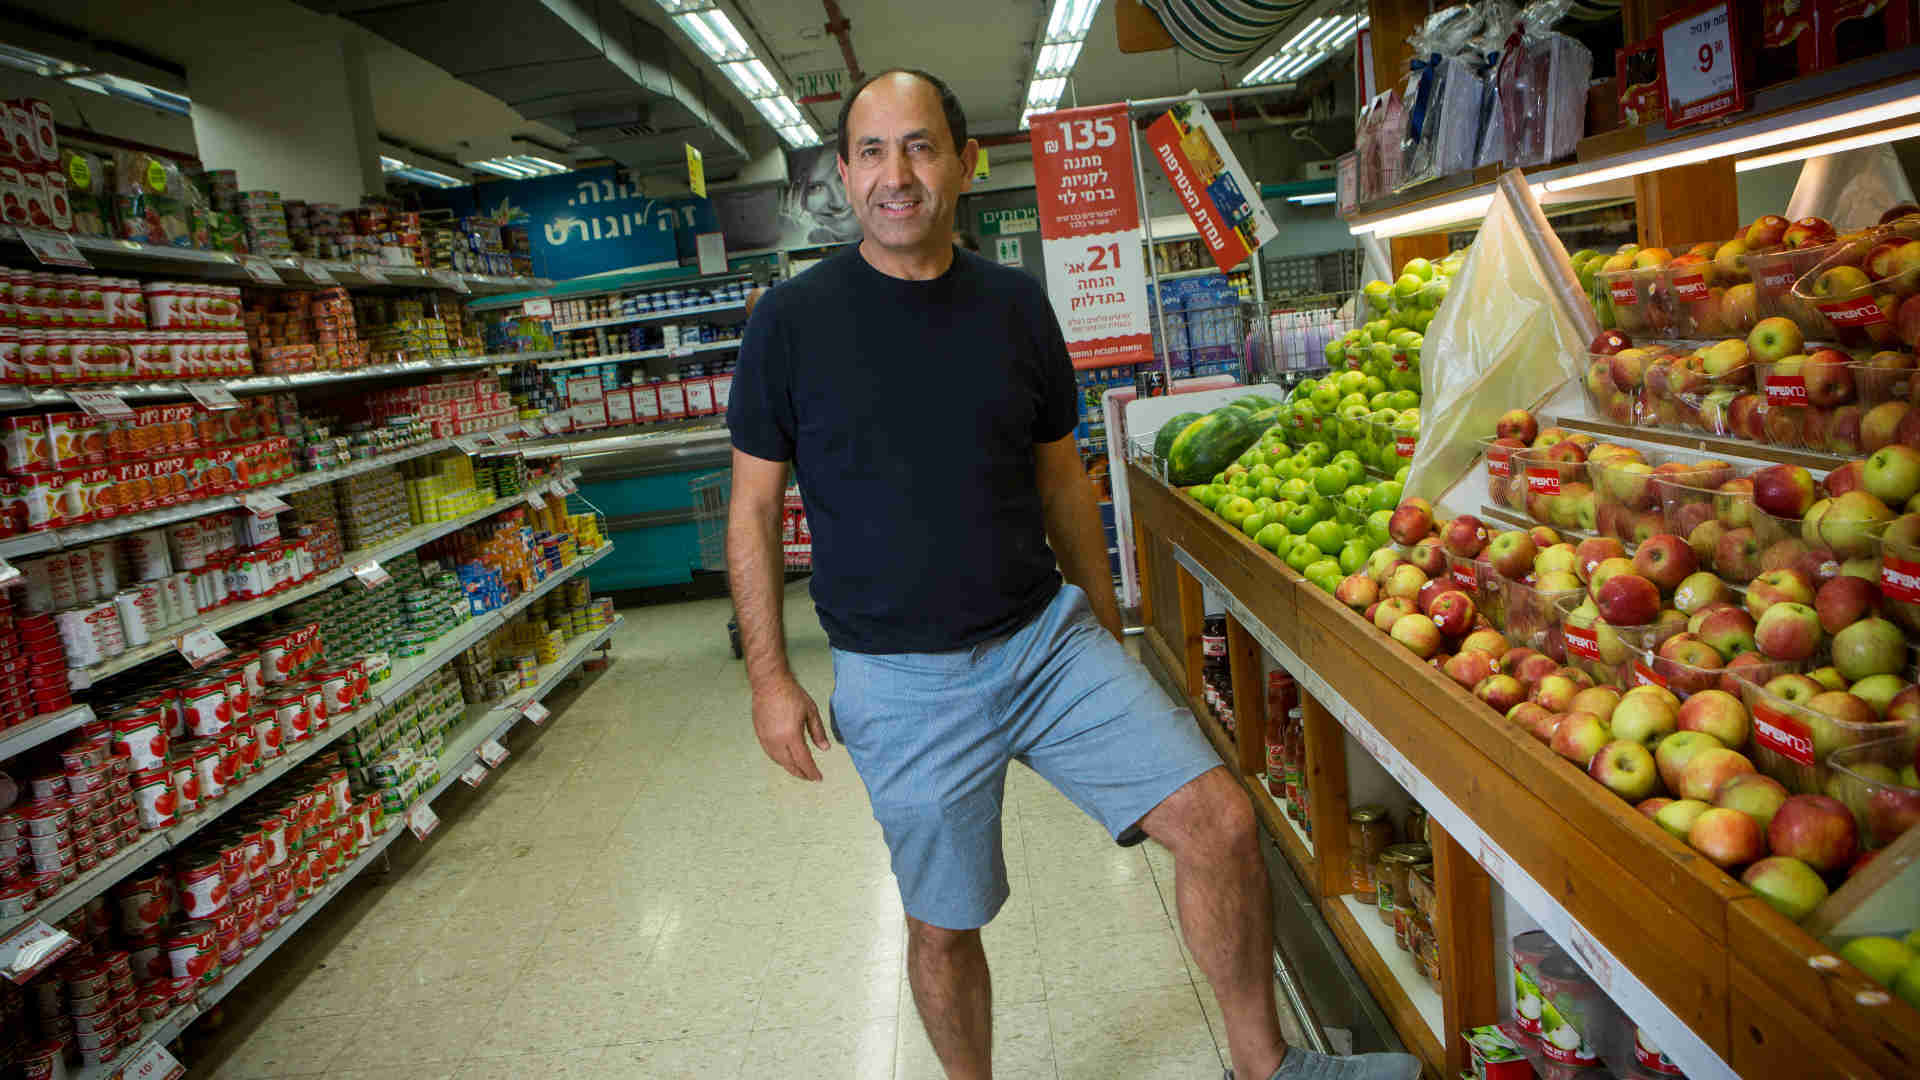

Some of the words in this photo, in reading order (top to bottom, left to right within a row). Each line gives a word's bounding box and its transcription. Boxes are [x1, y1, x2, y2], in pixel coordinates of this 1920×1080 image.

[1698, 43, 1714, 73] 9
[796, 72, 841, 97] יציאה
[1059, 117, 1116, 151] 135
[1064, 155, 1102, 170] מתנה
[1060, 168, 1108, 188] לקניות
[1157, 143, 1201, 209] הצטרפות
[1057, 189, 1077, 205] לוי
[1080, 188, 1115, 202] ברמי
[544, 210, 645, 246] יוגורט
[657, 205, 697, 232] זה
[1194, 207, 1225, 251] עמדת
[1087, 242, 1121, 272] 21
[1078, 276, 1115, 290] הנחה
[1070, 292, 1126, 312] בתדלוק
